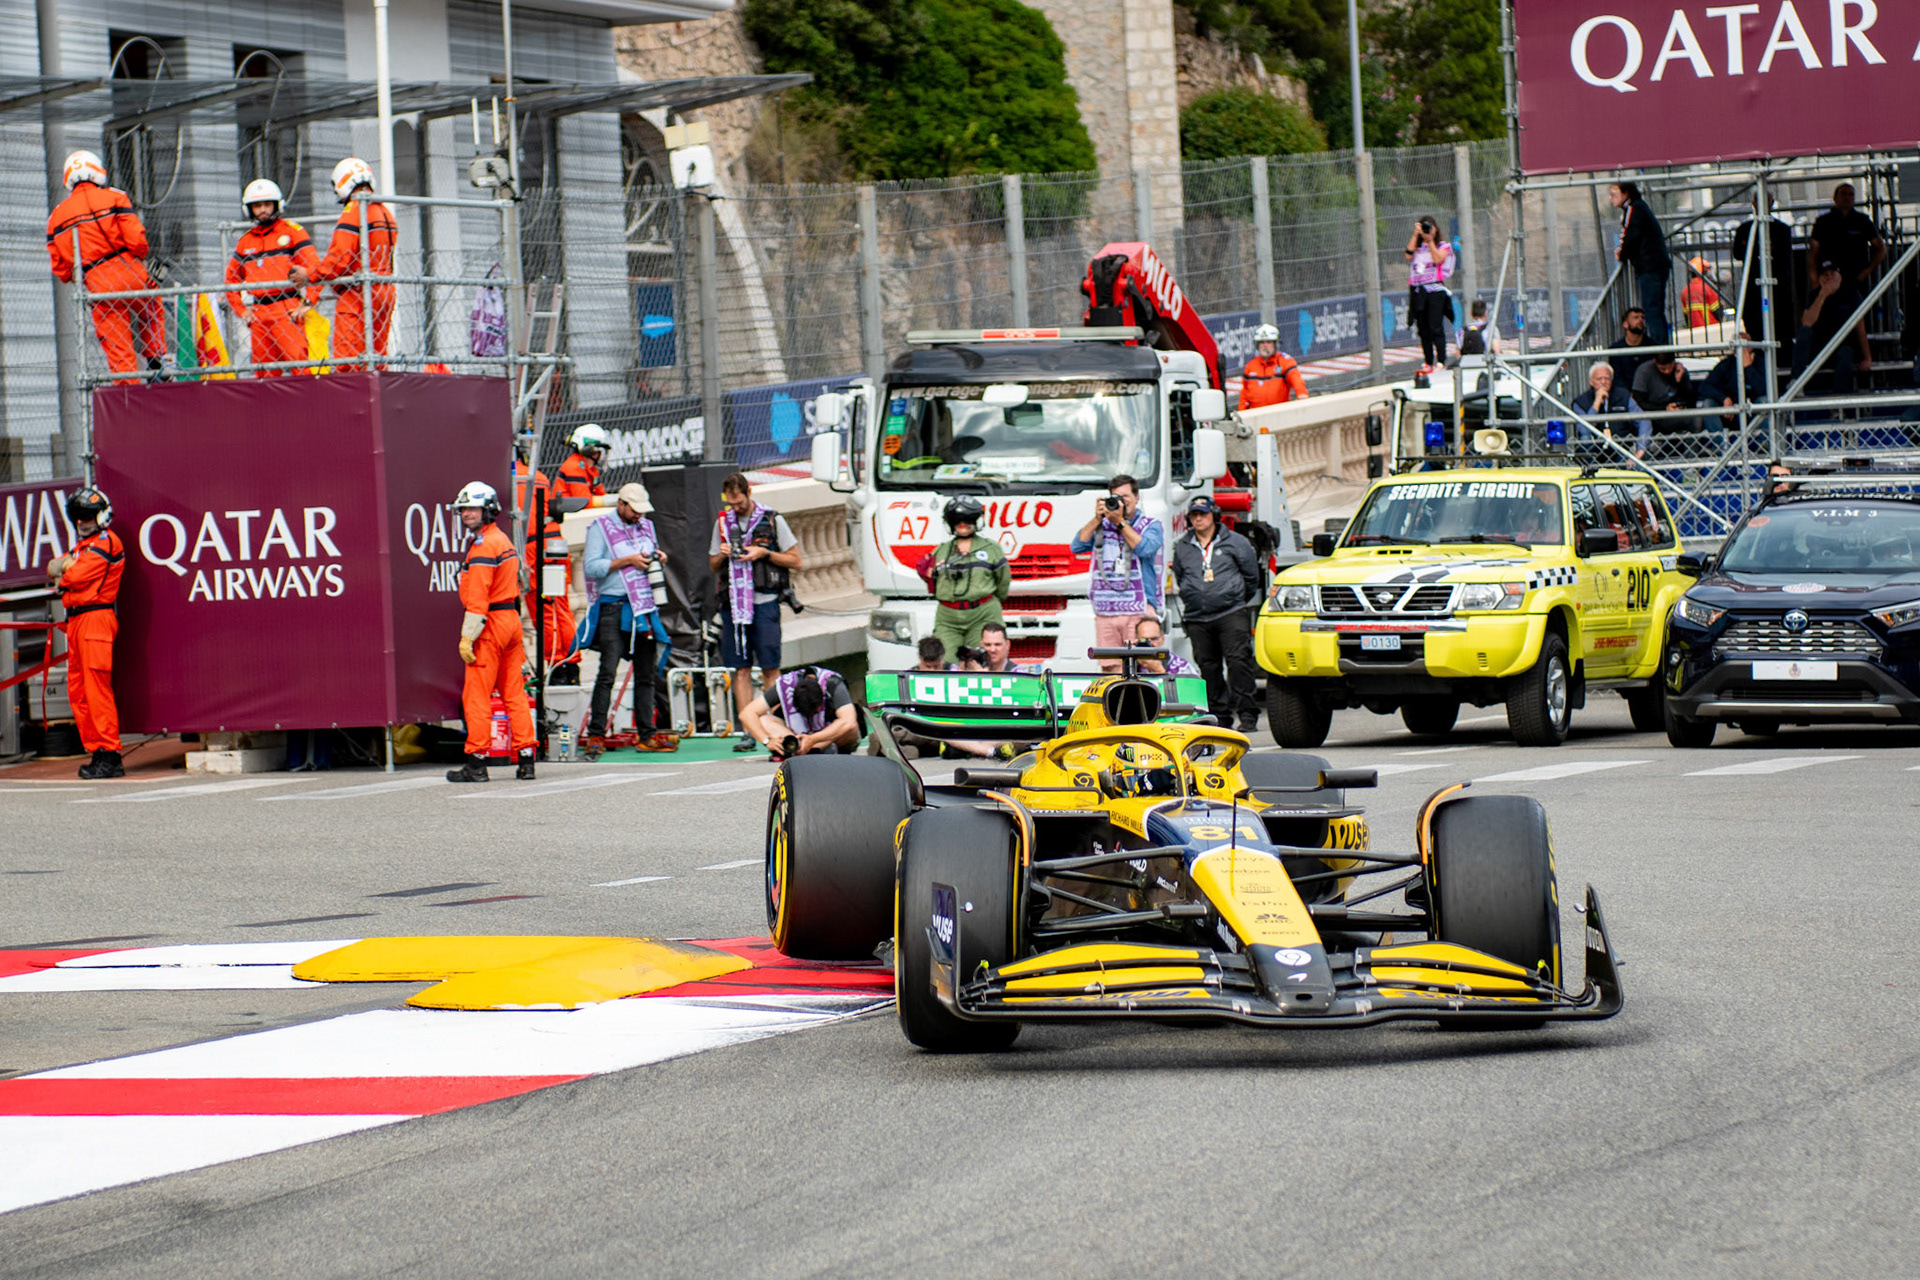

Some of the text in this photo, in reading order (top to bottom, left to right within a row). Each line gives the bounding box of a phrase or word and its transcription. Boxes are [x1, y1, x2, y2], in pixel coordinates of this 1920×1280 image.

[1570, 0, 1887, 93] QATAR
[1141, 244, 1183, 321] MILLO
[1388, 483, 1535, 500] SECURITE CIRCUIT
[139, 506, 342, 577] QATAR
[404, 502, 474, 567] QAT
[898, 516, 930, 540] A7
[188, 563, 345, 602] AIRWAYS
[1627, 566, 1650, 612] 210
[1371, 637, 1399, 648] 0130
[914, 676, 1013, 705] OKX
[1111, 810, 1143, 833] RICHARD MILLE
[1188, 825, 1259, 841] 81
